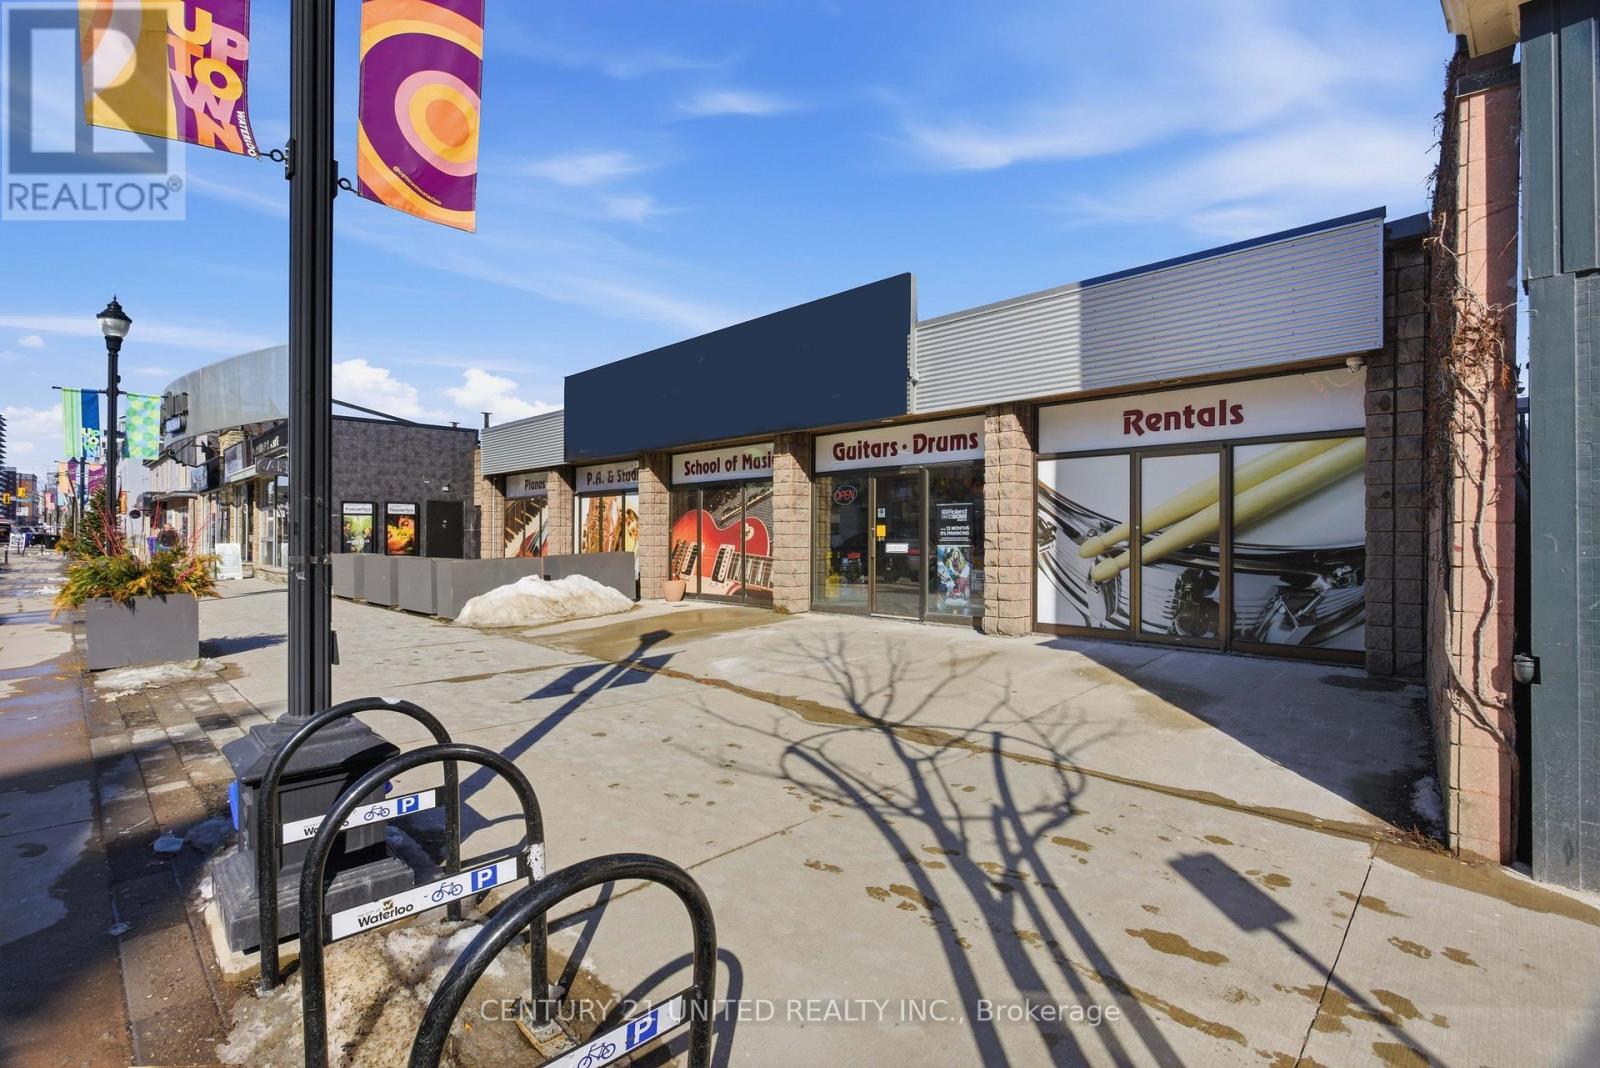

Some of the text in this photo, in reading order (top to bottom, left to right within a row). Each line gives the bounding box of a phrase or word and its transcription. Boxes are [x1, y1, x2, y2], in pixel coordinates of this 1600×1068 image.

[237, 110, 257, 157] WATERLOO
[1123, 399, 1244, 436] Rentals
[833, 432, 979, 461] Guitars Drums
[684, 457, 720, 476] School
[725, 455, 738, 472] of
[525, 479, 546, 491] Pianos
[587, 471, 604, 485] P.A.
[608, 470, 614, 483] &
[835, 489, 855, 501] OPEN
[358, 904, 414, 927] Waterloo
